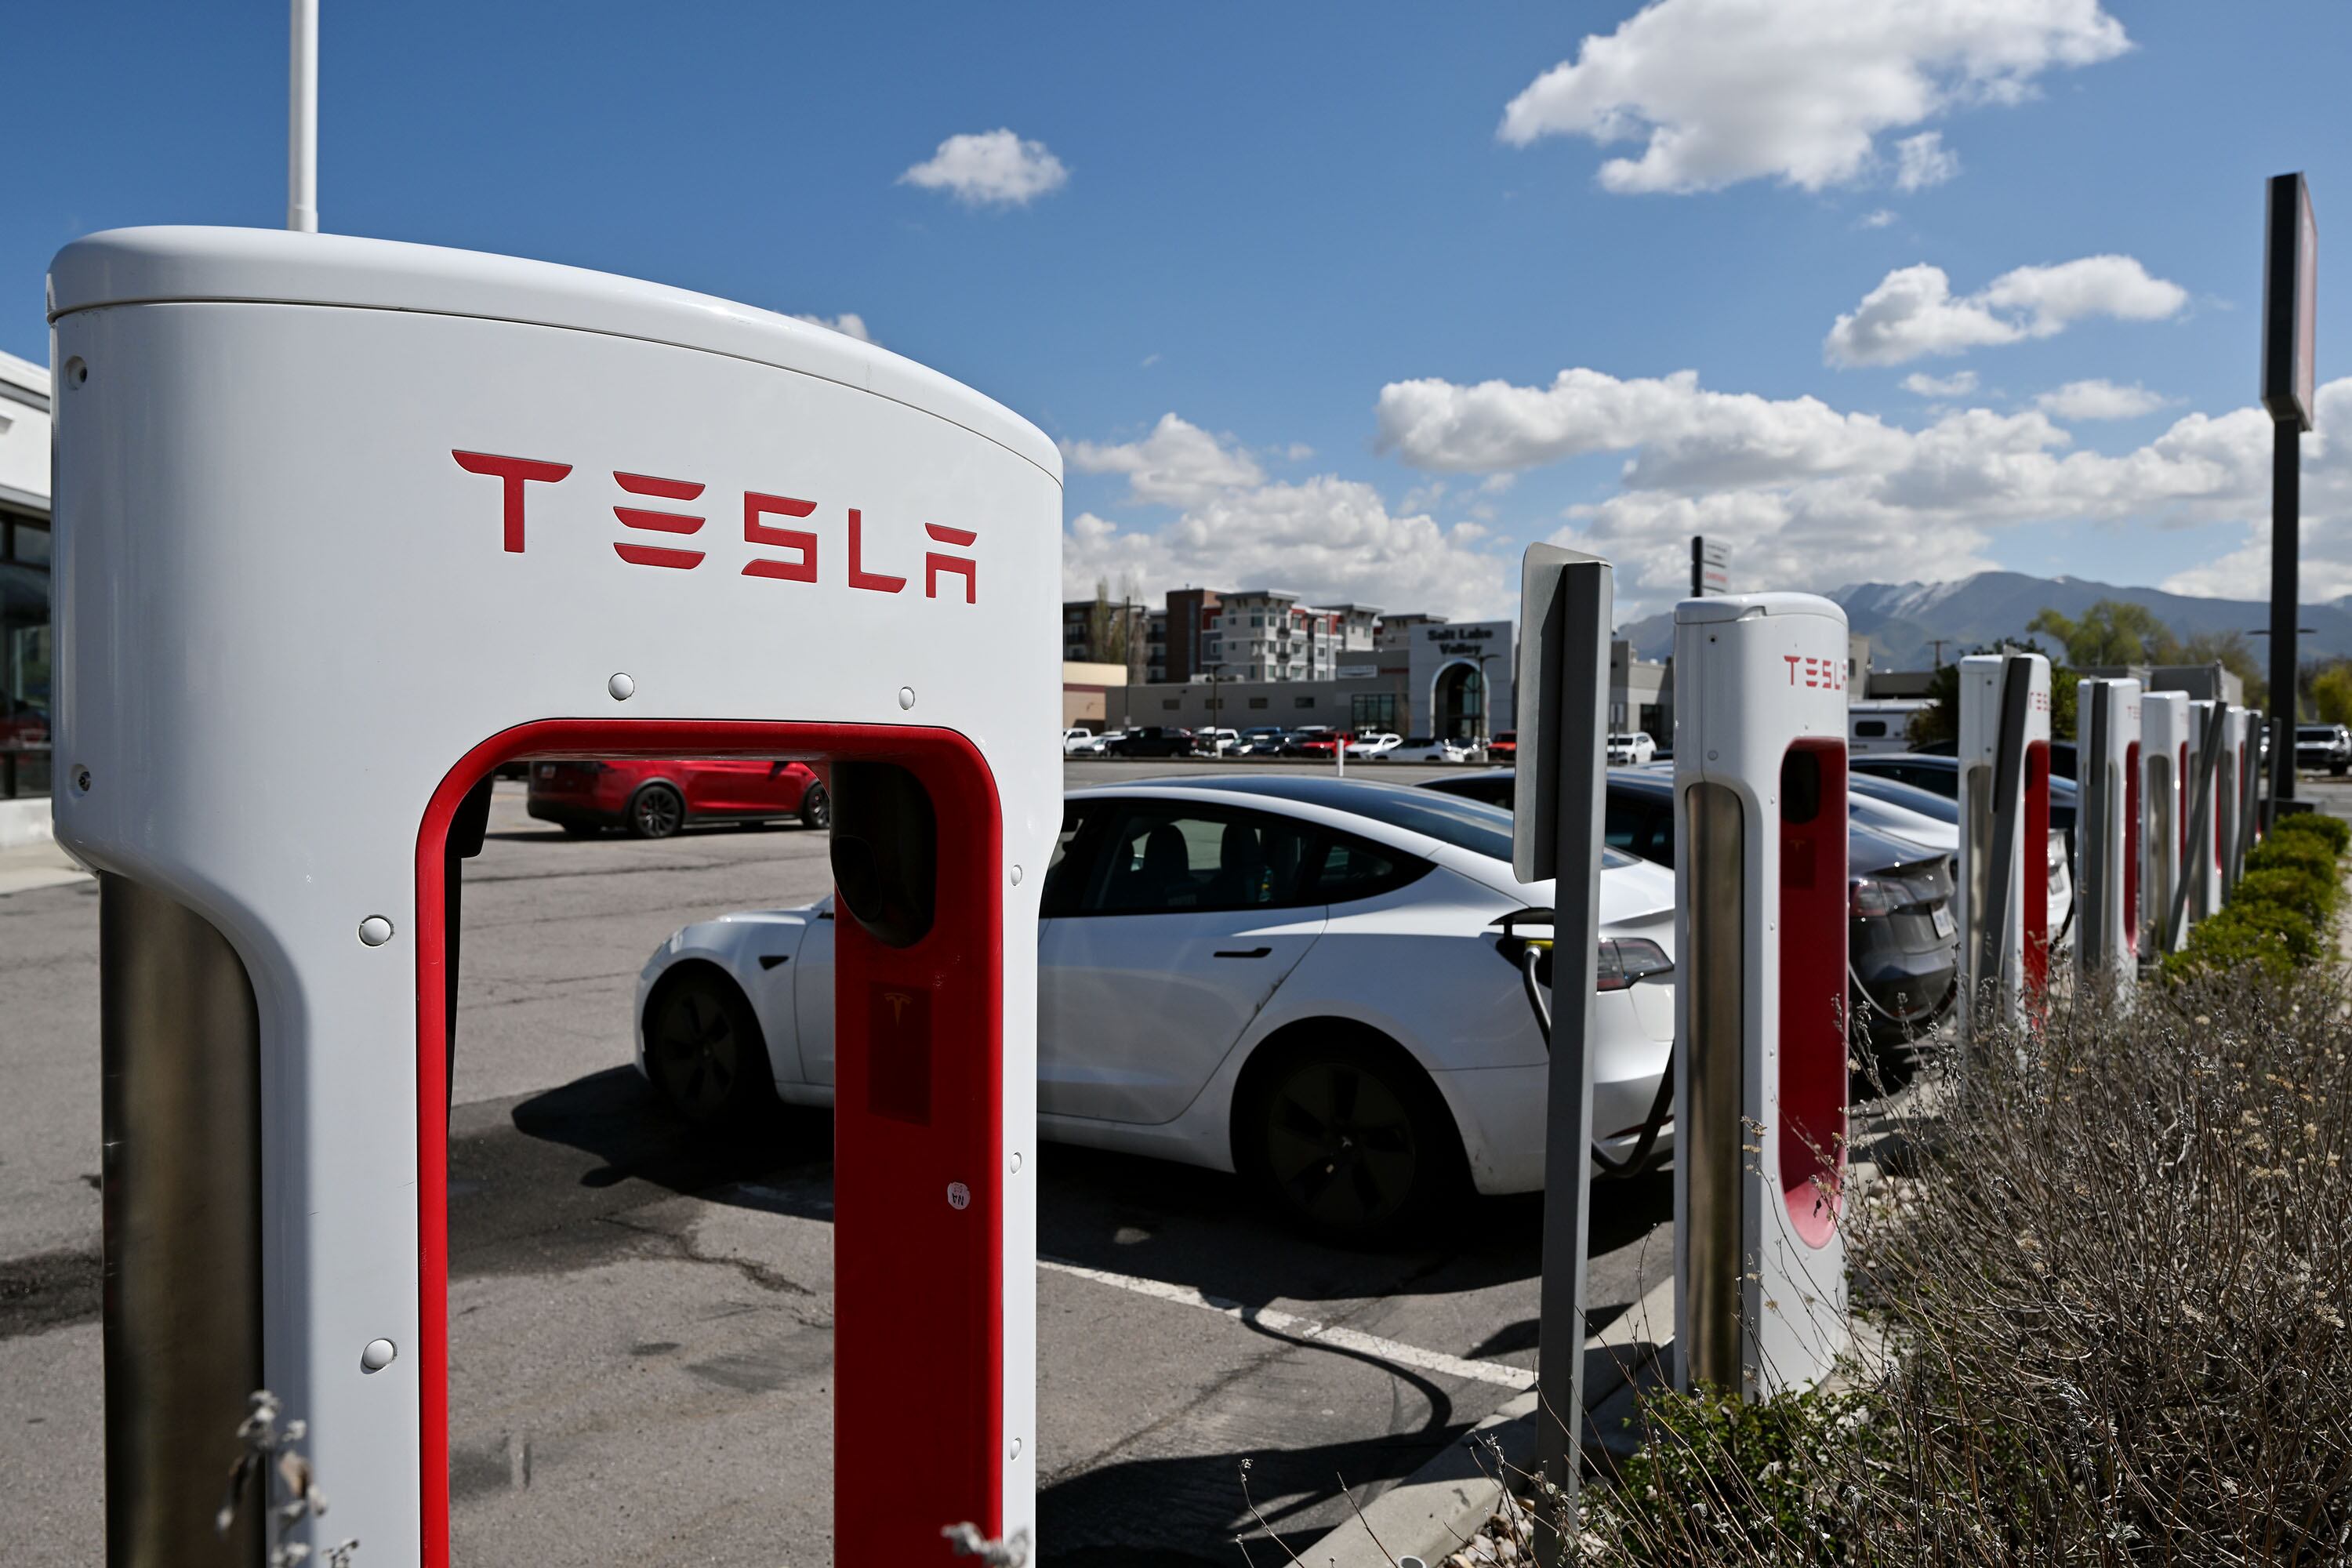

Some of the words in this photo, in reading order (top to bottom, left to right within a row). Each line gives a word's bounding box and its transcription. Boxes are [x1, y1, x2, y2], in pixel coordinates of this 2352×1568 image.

[452, 449, 977, 604] TESLA
[1459, 627, 1494, 640] Lake
[1439, 643, 1483, 655] Valley
